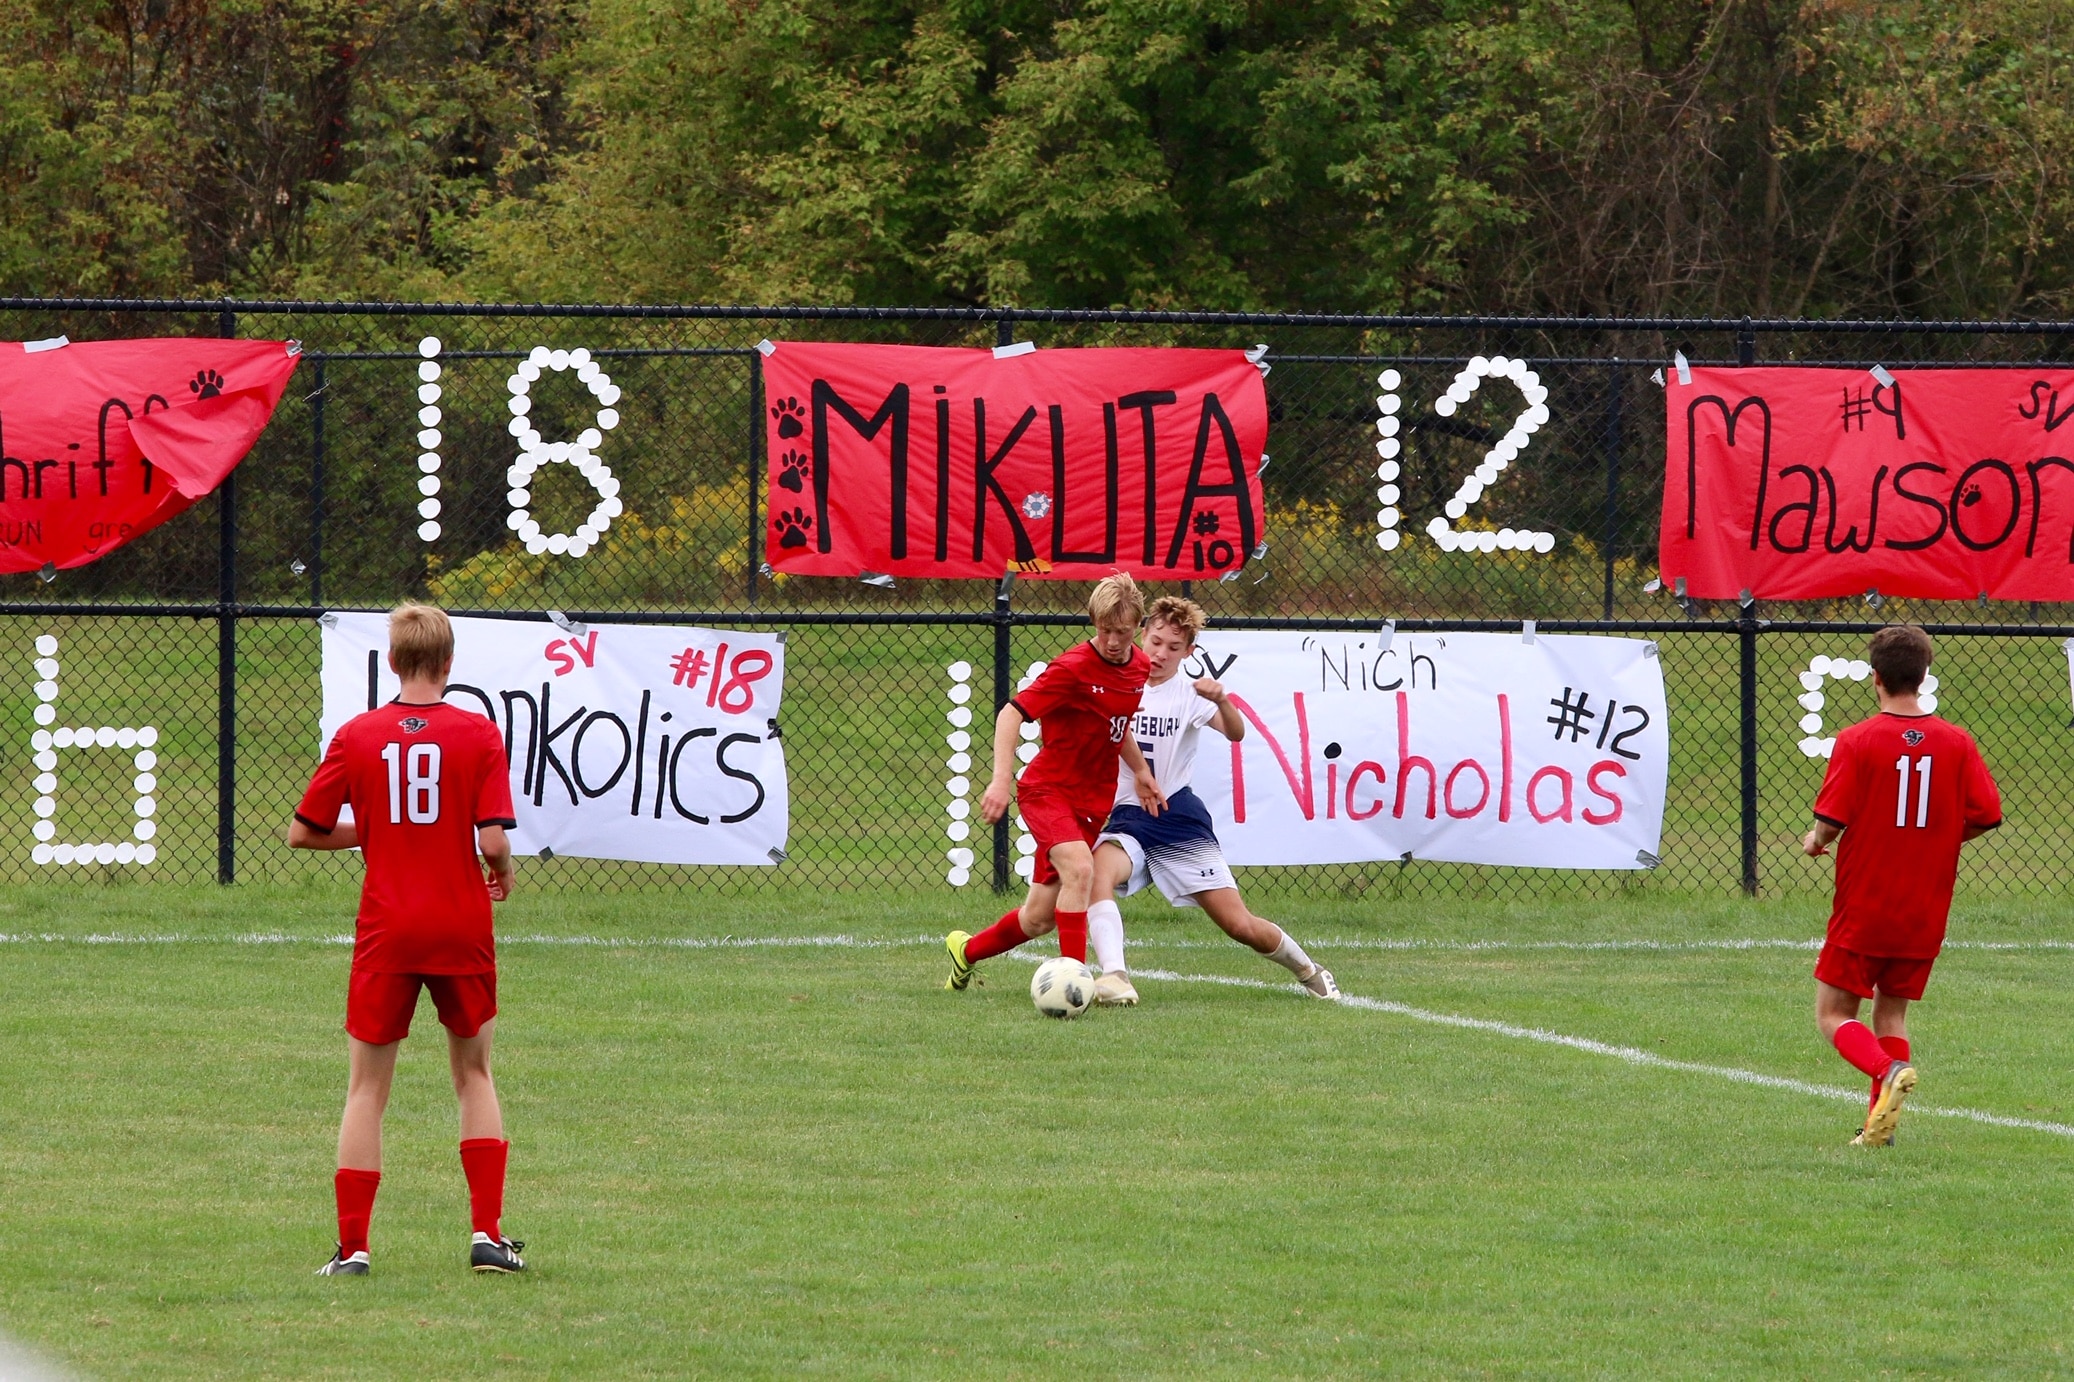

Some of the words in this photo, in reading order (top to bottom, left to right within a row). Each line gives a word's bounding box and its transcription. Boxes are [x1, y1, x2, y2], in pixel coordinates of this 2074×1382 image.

[416, 336, 622, 557] 18
[1838, 381, 1905, 441] #9
[1375, 355, 1555, 553] 12
[669, 642, 773, 715] #18
[1227, 691, 1628, 826] Nicholas
[1547, 687, 1650, 761] #12
[380, 742, 441, 826] 18
[1896, 755, 1932, 828] 11
